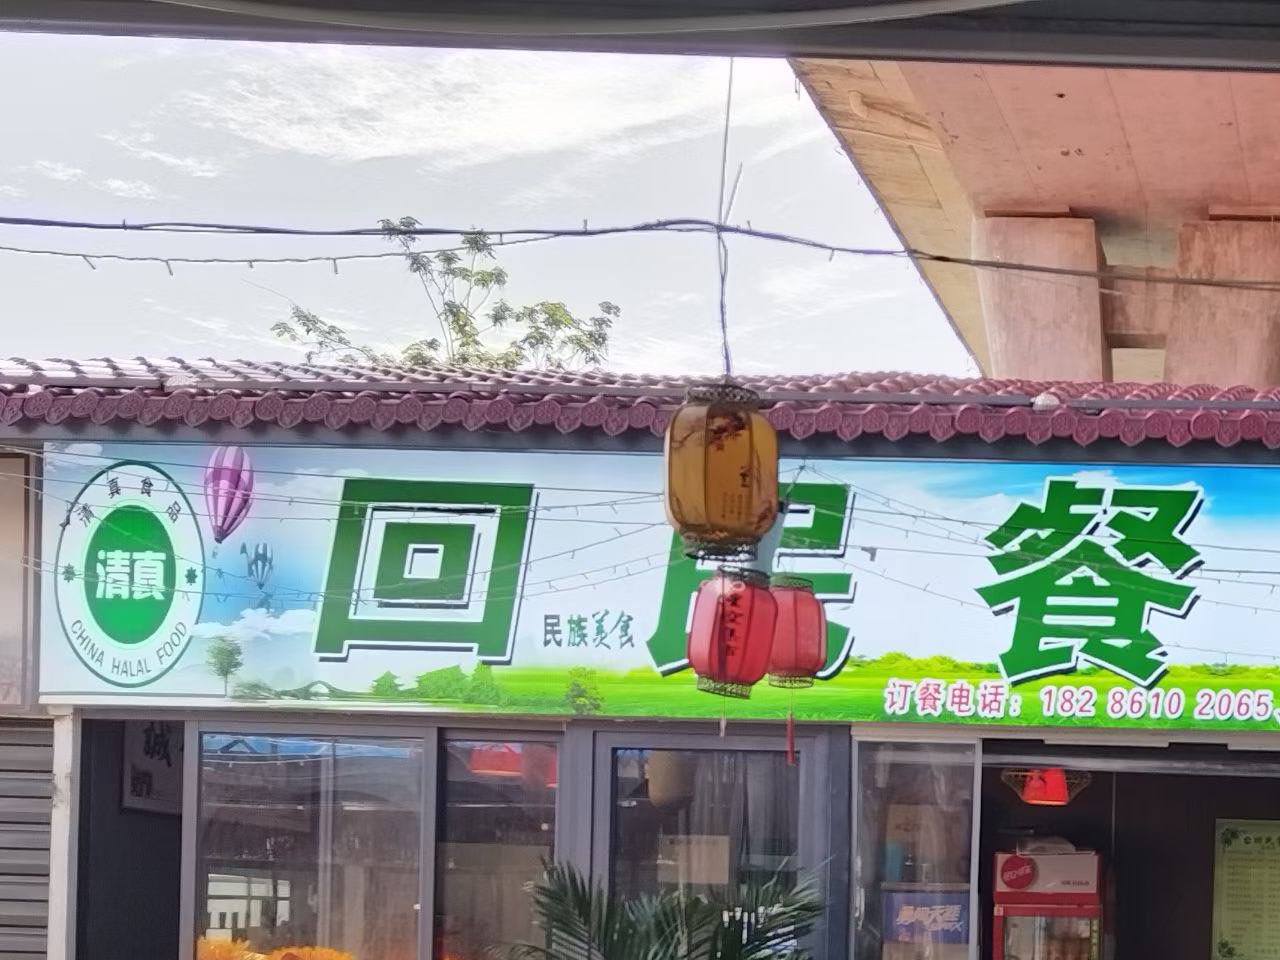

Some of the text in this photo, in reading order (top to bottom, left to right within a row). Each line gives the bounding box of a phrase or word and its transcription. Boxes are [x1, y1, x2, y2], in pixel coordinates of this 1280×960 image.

[75, 476, 182, 527] 清真食品
[96, 549, 167, 600] 清真
[72, 619, 187, 678] CHINA HALAL FOOD
[542, 610, 635, 651] 民族美食
[1042, 687, 1095, 717] 182
[1108, 688, 1183, 718] 8610
